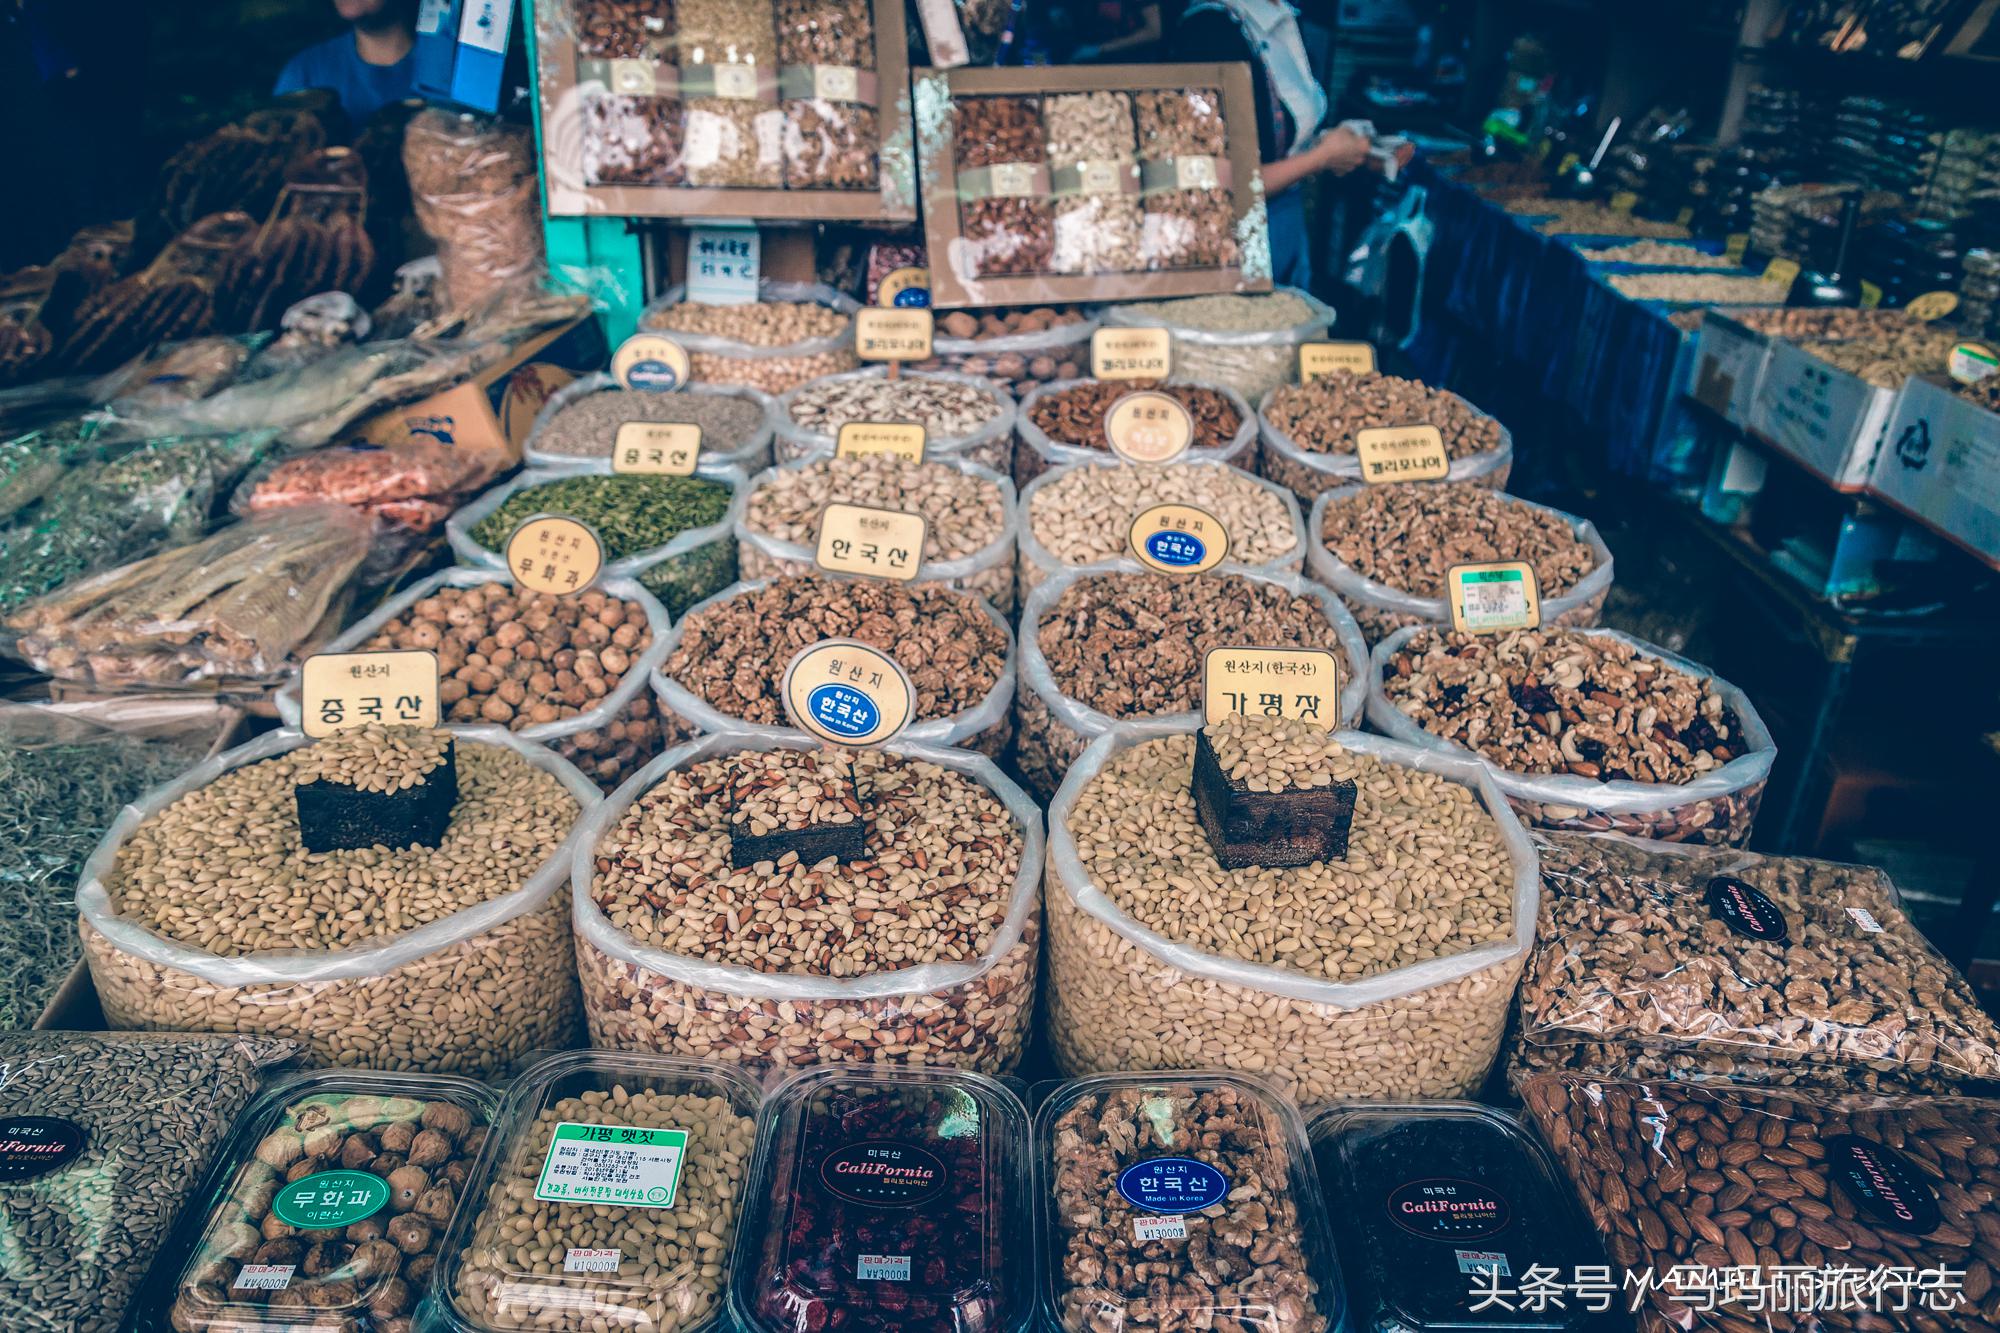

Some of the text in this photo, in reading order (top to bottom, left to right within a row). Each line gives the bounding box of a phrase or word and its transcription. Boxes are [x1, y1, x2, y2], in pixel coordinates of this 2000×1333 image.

[350, 664, 390, 678] 원산지
[829, 659, 883, 689] 원산지
[1224, 659, 1317, 676] 원산지(한국산)
[320, 695, 423, 724] 중국산
[821, 696, 868, 725] 한국산
[8, 1127, 44, 1136] 미국산
[579, 1126, 655, 1145] 가평 햇잣
[868, 1149, 901, 1159] 미국산
[835, 1161, 934, 1178] CaliFornia
[1154, 1165, 1187, 1174] 원산지
[319, 1179, 355, 1189] 원산지
[1140, 1177, 1209, 1192] 한국산
[1851, 1146, 1913, 1220] CaliFornia
[1423, 1186, 1456, 1196] 미국산
[293, 1190, 372, 1208] 무화과
[1402, 1198, 1497, 1213] CaliFornia
[307, 1211, 344, 1220] 이란산
[1140, 1217, 1177, 1227] 판매가격
